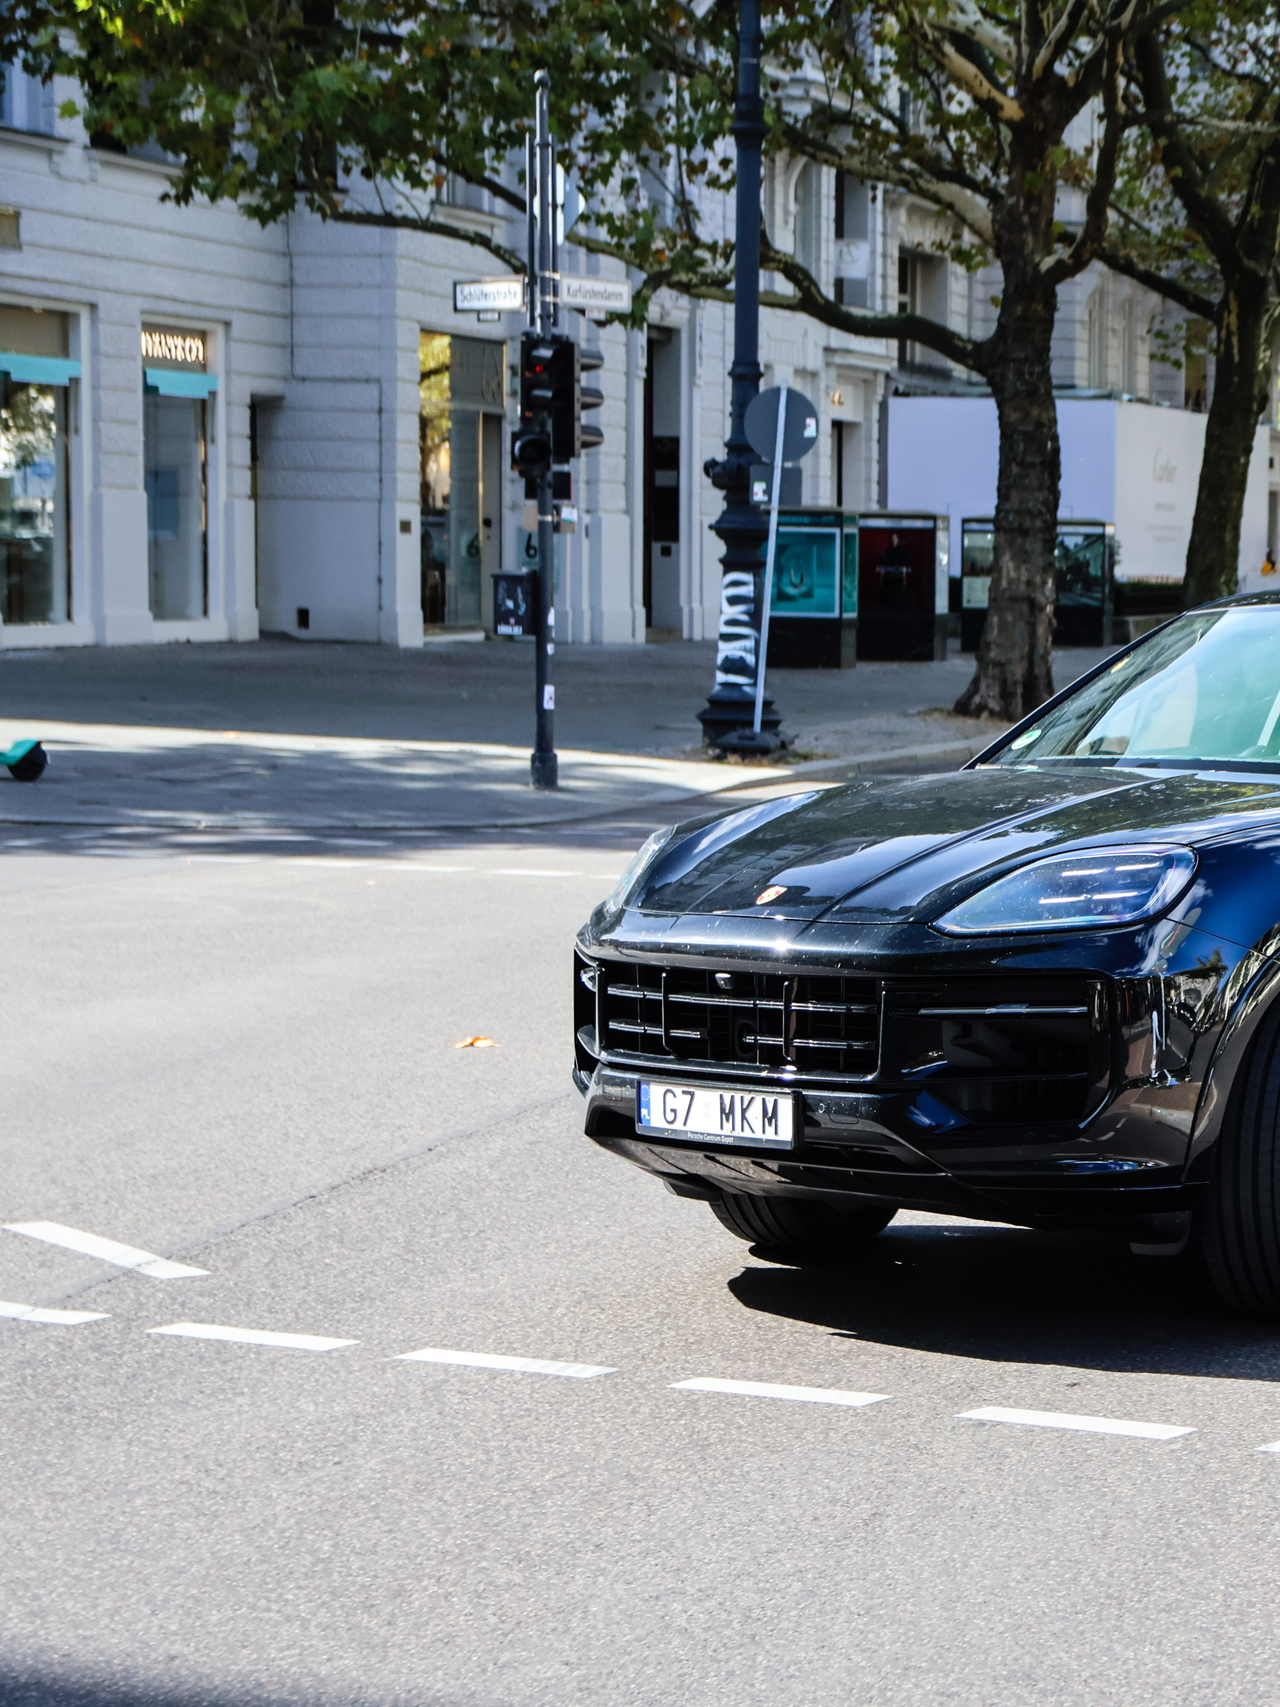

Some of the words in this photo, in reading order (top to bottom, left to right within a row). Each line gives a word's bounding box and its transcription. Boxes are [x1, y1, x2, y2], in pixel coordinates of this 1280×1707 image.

[460, 287, 518, 304] Schlüterstraße
[566, 284, 624, 301] Kurfürstendamm
[641, 1108, 650, 1120] PL
[663, 1088, 695, 1127] G7
[719, 1093, 779, 1136] MKM
[687, 1131, 703, 1140] Porsche
[703, 1133, 721, 1142] Centrum
